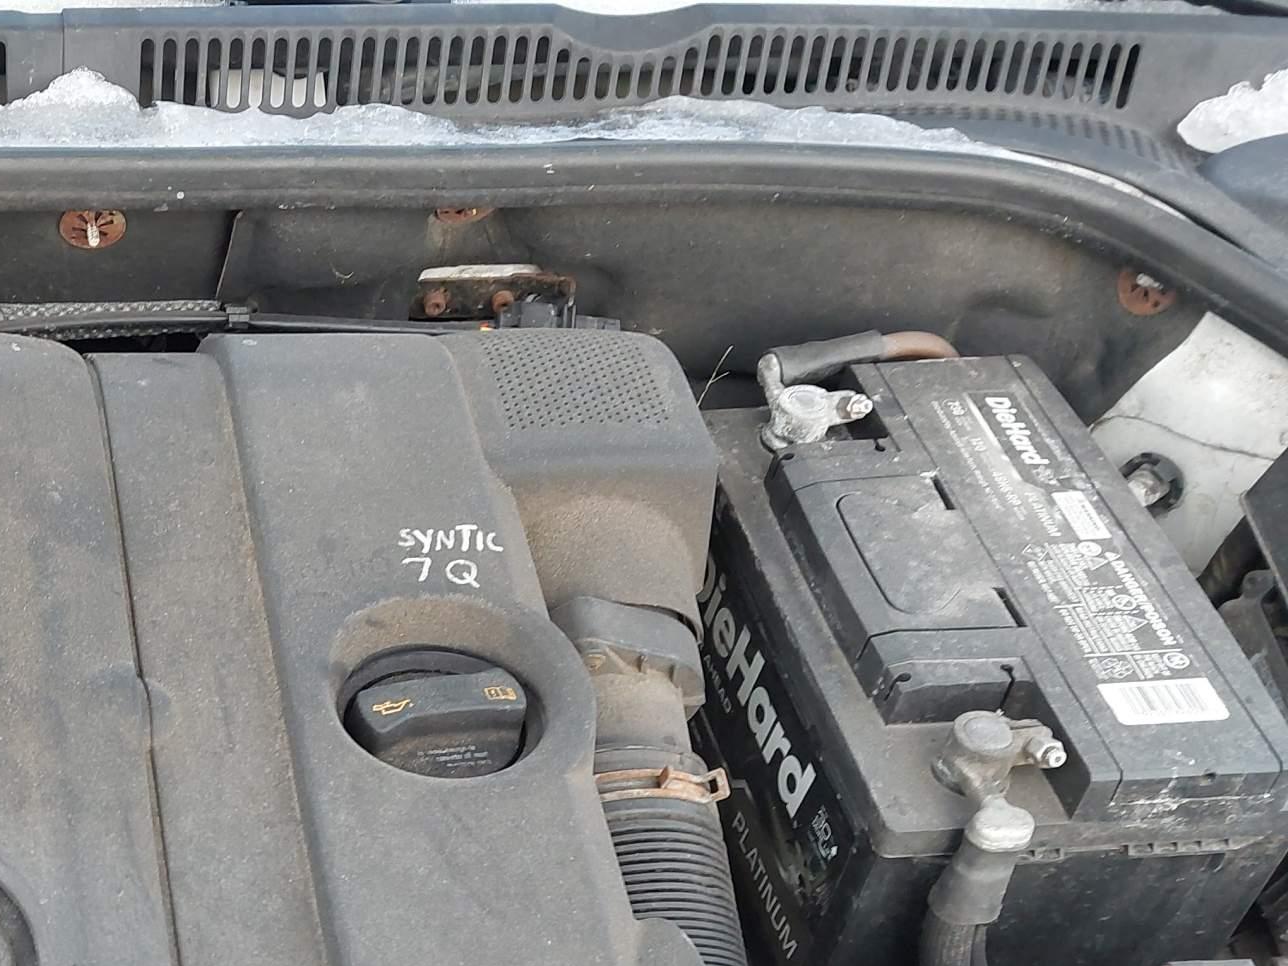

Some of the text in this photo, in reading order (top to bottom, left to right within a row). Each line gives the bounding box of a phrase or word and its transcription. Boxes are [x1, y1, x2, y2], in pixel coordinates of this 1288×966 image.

[985, 397, 1050, 465] DieHard
[1024, 491, 1062, 537] PLATINUM
[397, 524, 504, 554] SYNTIC
[401, 557, 480, 588] 7 Q
[732, 811, 798, 960] PLATINUM
